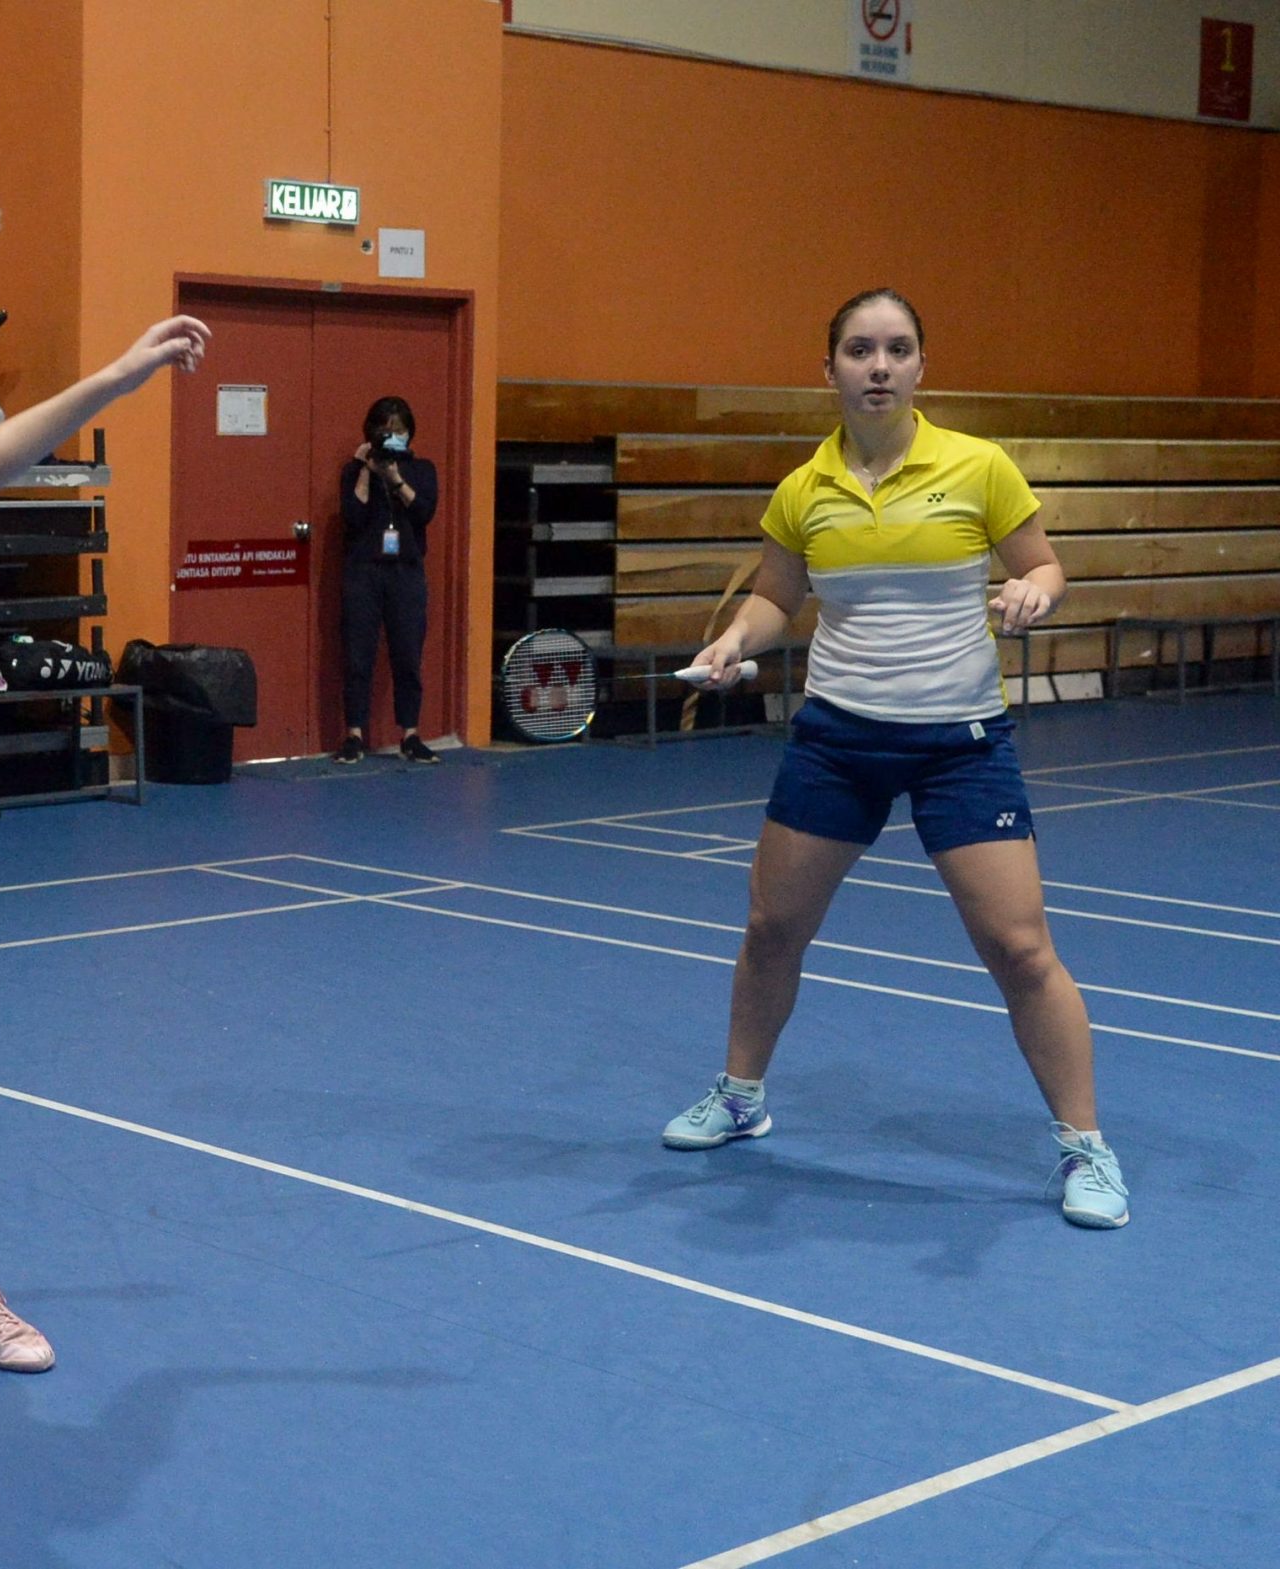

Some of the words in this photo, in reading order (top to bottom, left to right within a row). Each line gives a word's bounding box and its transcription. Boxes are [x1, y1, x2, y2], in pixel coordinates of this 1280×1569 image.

[1220, 27, 1236, 71] 1
[272, 184, 341, 219] KELUAR
[211, 566, 242, 577] DITUTUP
